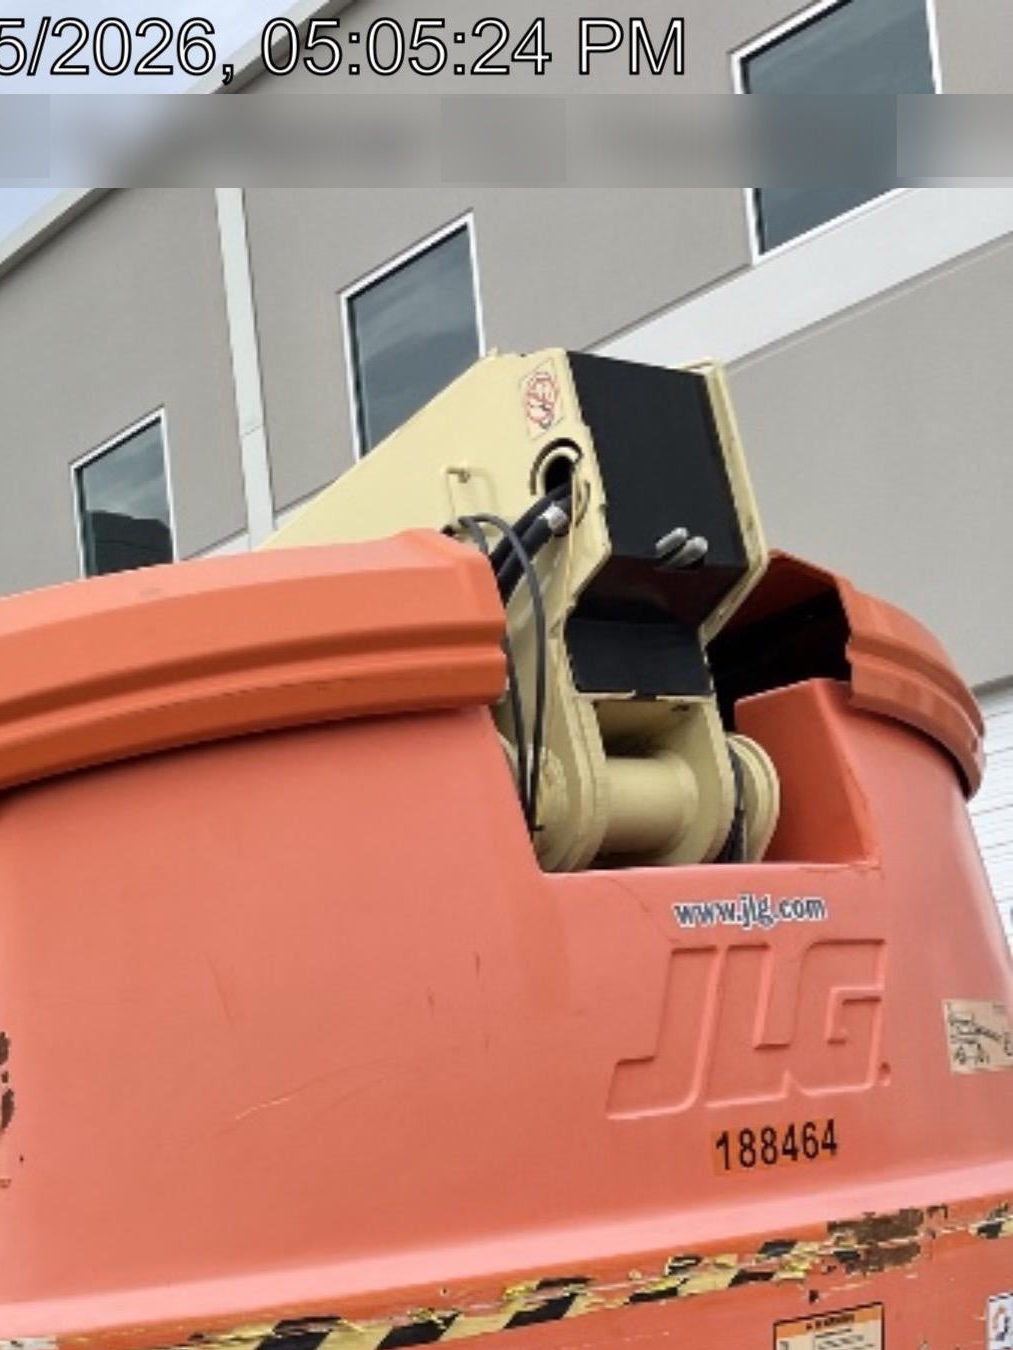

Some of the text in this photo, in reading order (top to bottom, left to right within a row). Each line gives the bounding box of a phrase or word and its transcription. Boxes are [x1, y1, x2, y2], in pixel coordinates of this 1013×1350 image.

[673, 894, 827, 930] www.jlg.com
[606, 938, 886, 1119] JLG
[715, 1119, 838, 1170] 188464
